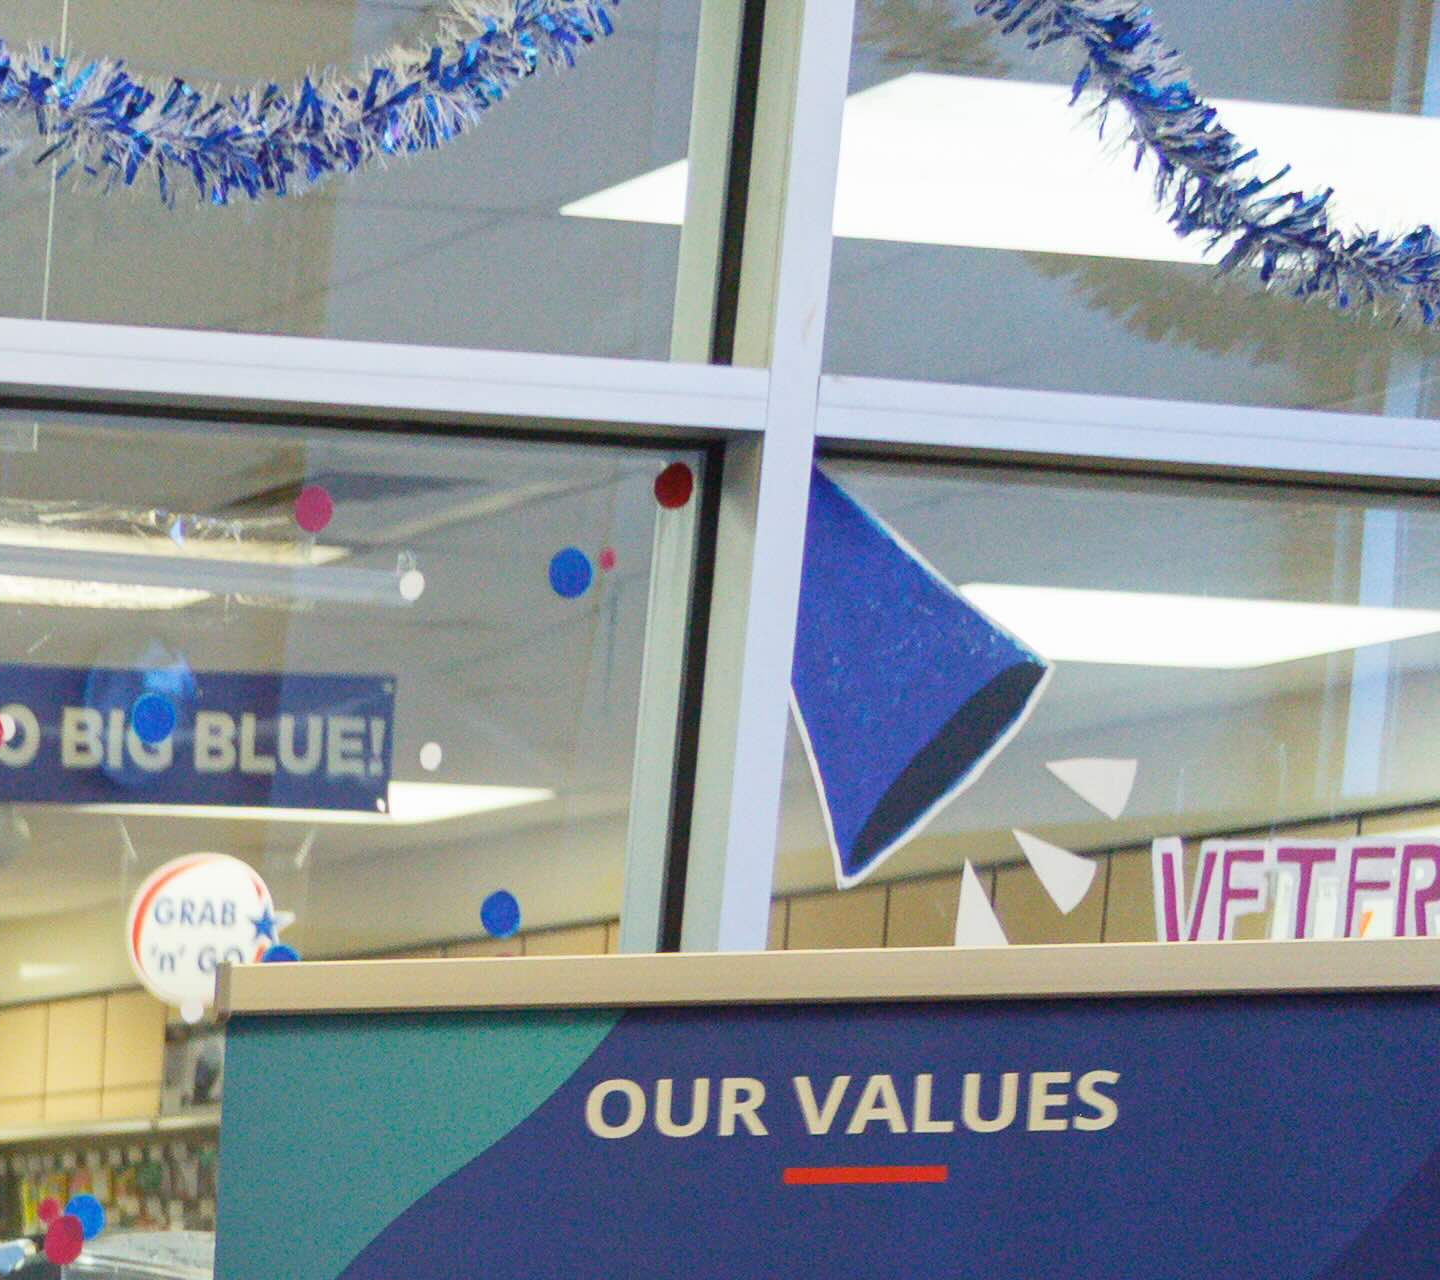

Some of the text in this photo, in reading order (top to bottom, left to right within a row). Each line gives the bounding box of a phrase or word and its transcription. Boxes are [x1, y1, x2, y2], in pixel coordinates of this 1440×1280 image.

[61, 706, 175, 770] BIG
[194, 711, 386, 777] BLUE!
[153, 899, 237, 927] GRAB
[197, 949, 246, 973] GO
[583, 1070, 1122, 1140] OUR VALUES
